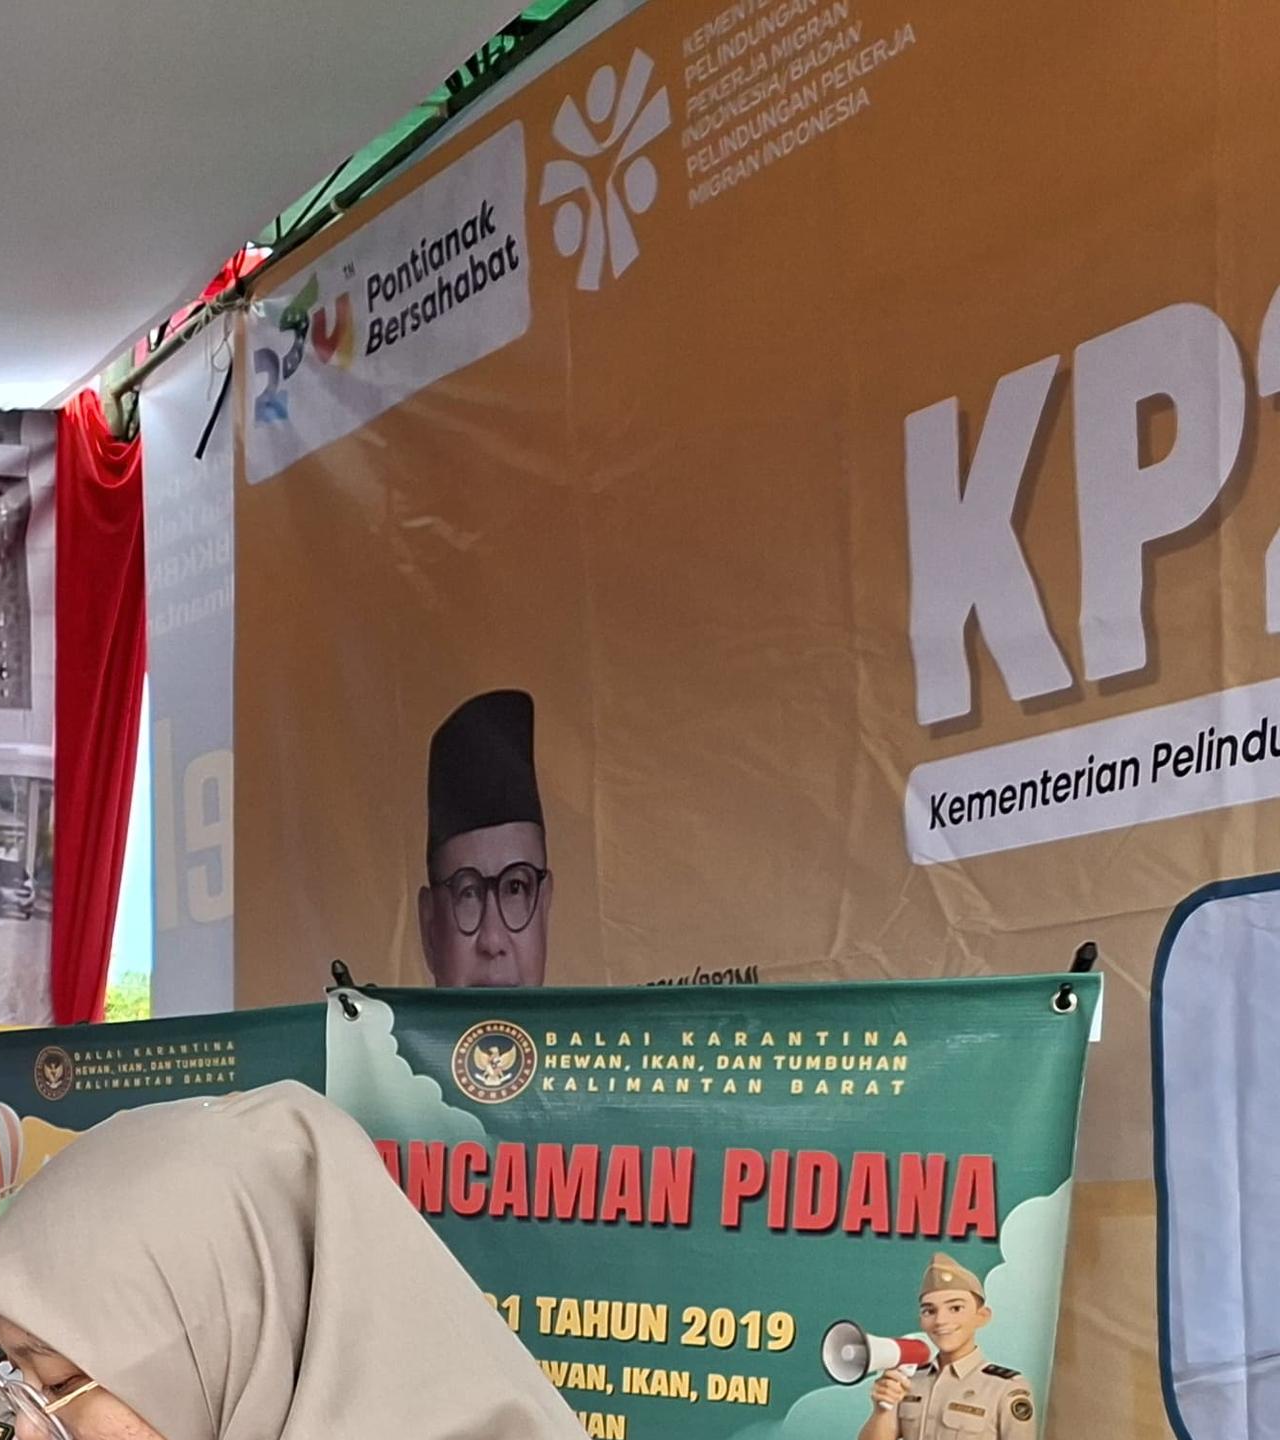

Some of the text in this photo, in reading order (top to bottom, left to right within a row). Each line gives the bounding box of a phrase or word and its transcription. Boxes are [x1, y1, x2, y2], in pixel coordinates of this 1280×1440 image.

[687, 80, 818, 178] PELINDUNGAN
[821, 22, 916, 96] PEKERJA
[763, 87, 871, 165] INDONESIA
[365, 232, 519, 356] Bersahabat
[367, 200, 496, 312] Pontianak
[903, 283, 1280, 727] KP
[928, 753, 1140, 830] Kementerian
[544, 1054, 909, 1073] HEWAN, IKAN, DAN TUMBUHAN
[545, 1030, 909, 1047] BALAI KARANTINA
[542, 1076, 907, 1096] KALIMANTAN BARAT
[720, 1148, 998, 1239] PIDANA
[536, 1296, 797, 1351] TAHUN 2019
[622, 1366, 771, 1405] IKAN, DAN
